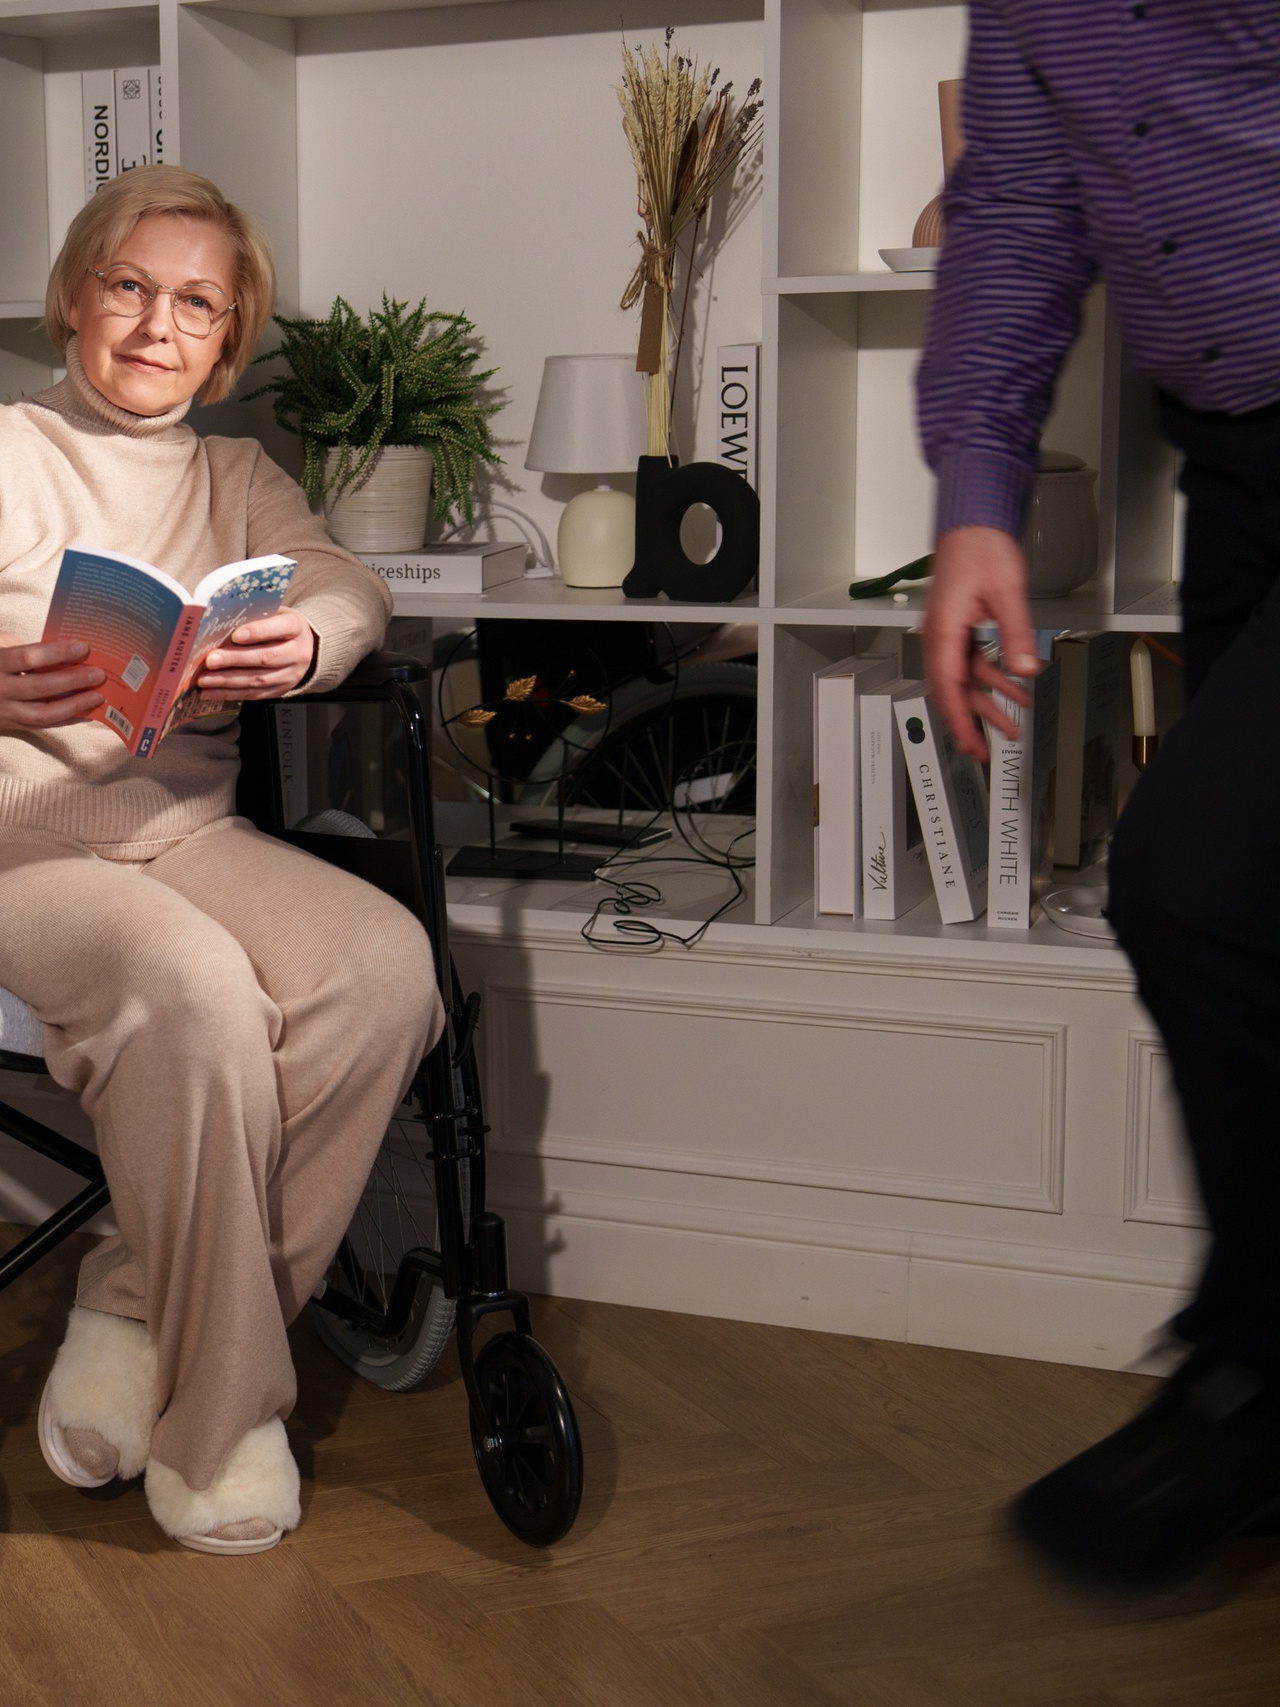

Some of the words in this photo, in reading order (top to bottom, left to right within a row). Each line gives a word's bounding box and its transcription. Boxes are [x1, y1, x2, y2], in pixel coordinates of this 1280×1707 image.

[183, 615, 195, 637] JANE
[169, 641, 184, 673] AUSTEN
[140, 738, 150, 752] C
[282, 708, 293, 783] KINFOLK
[1002, 757, 1020, 811] WITH
[918, 763, 956, 889] CHRISTIANE
[999, 819, 1019, 885] WHITE
